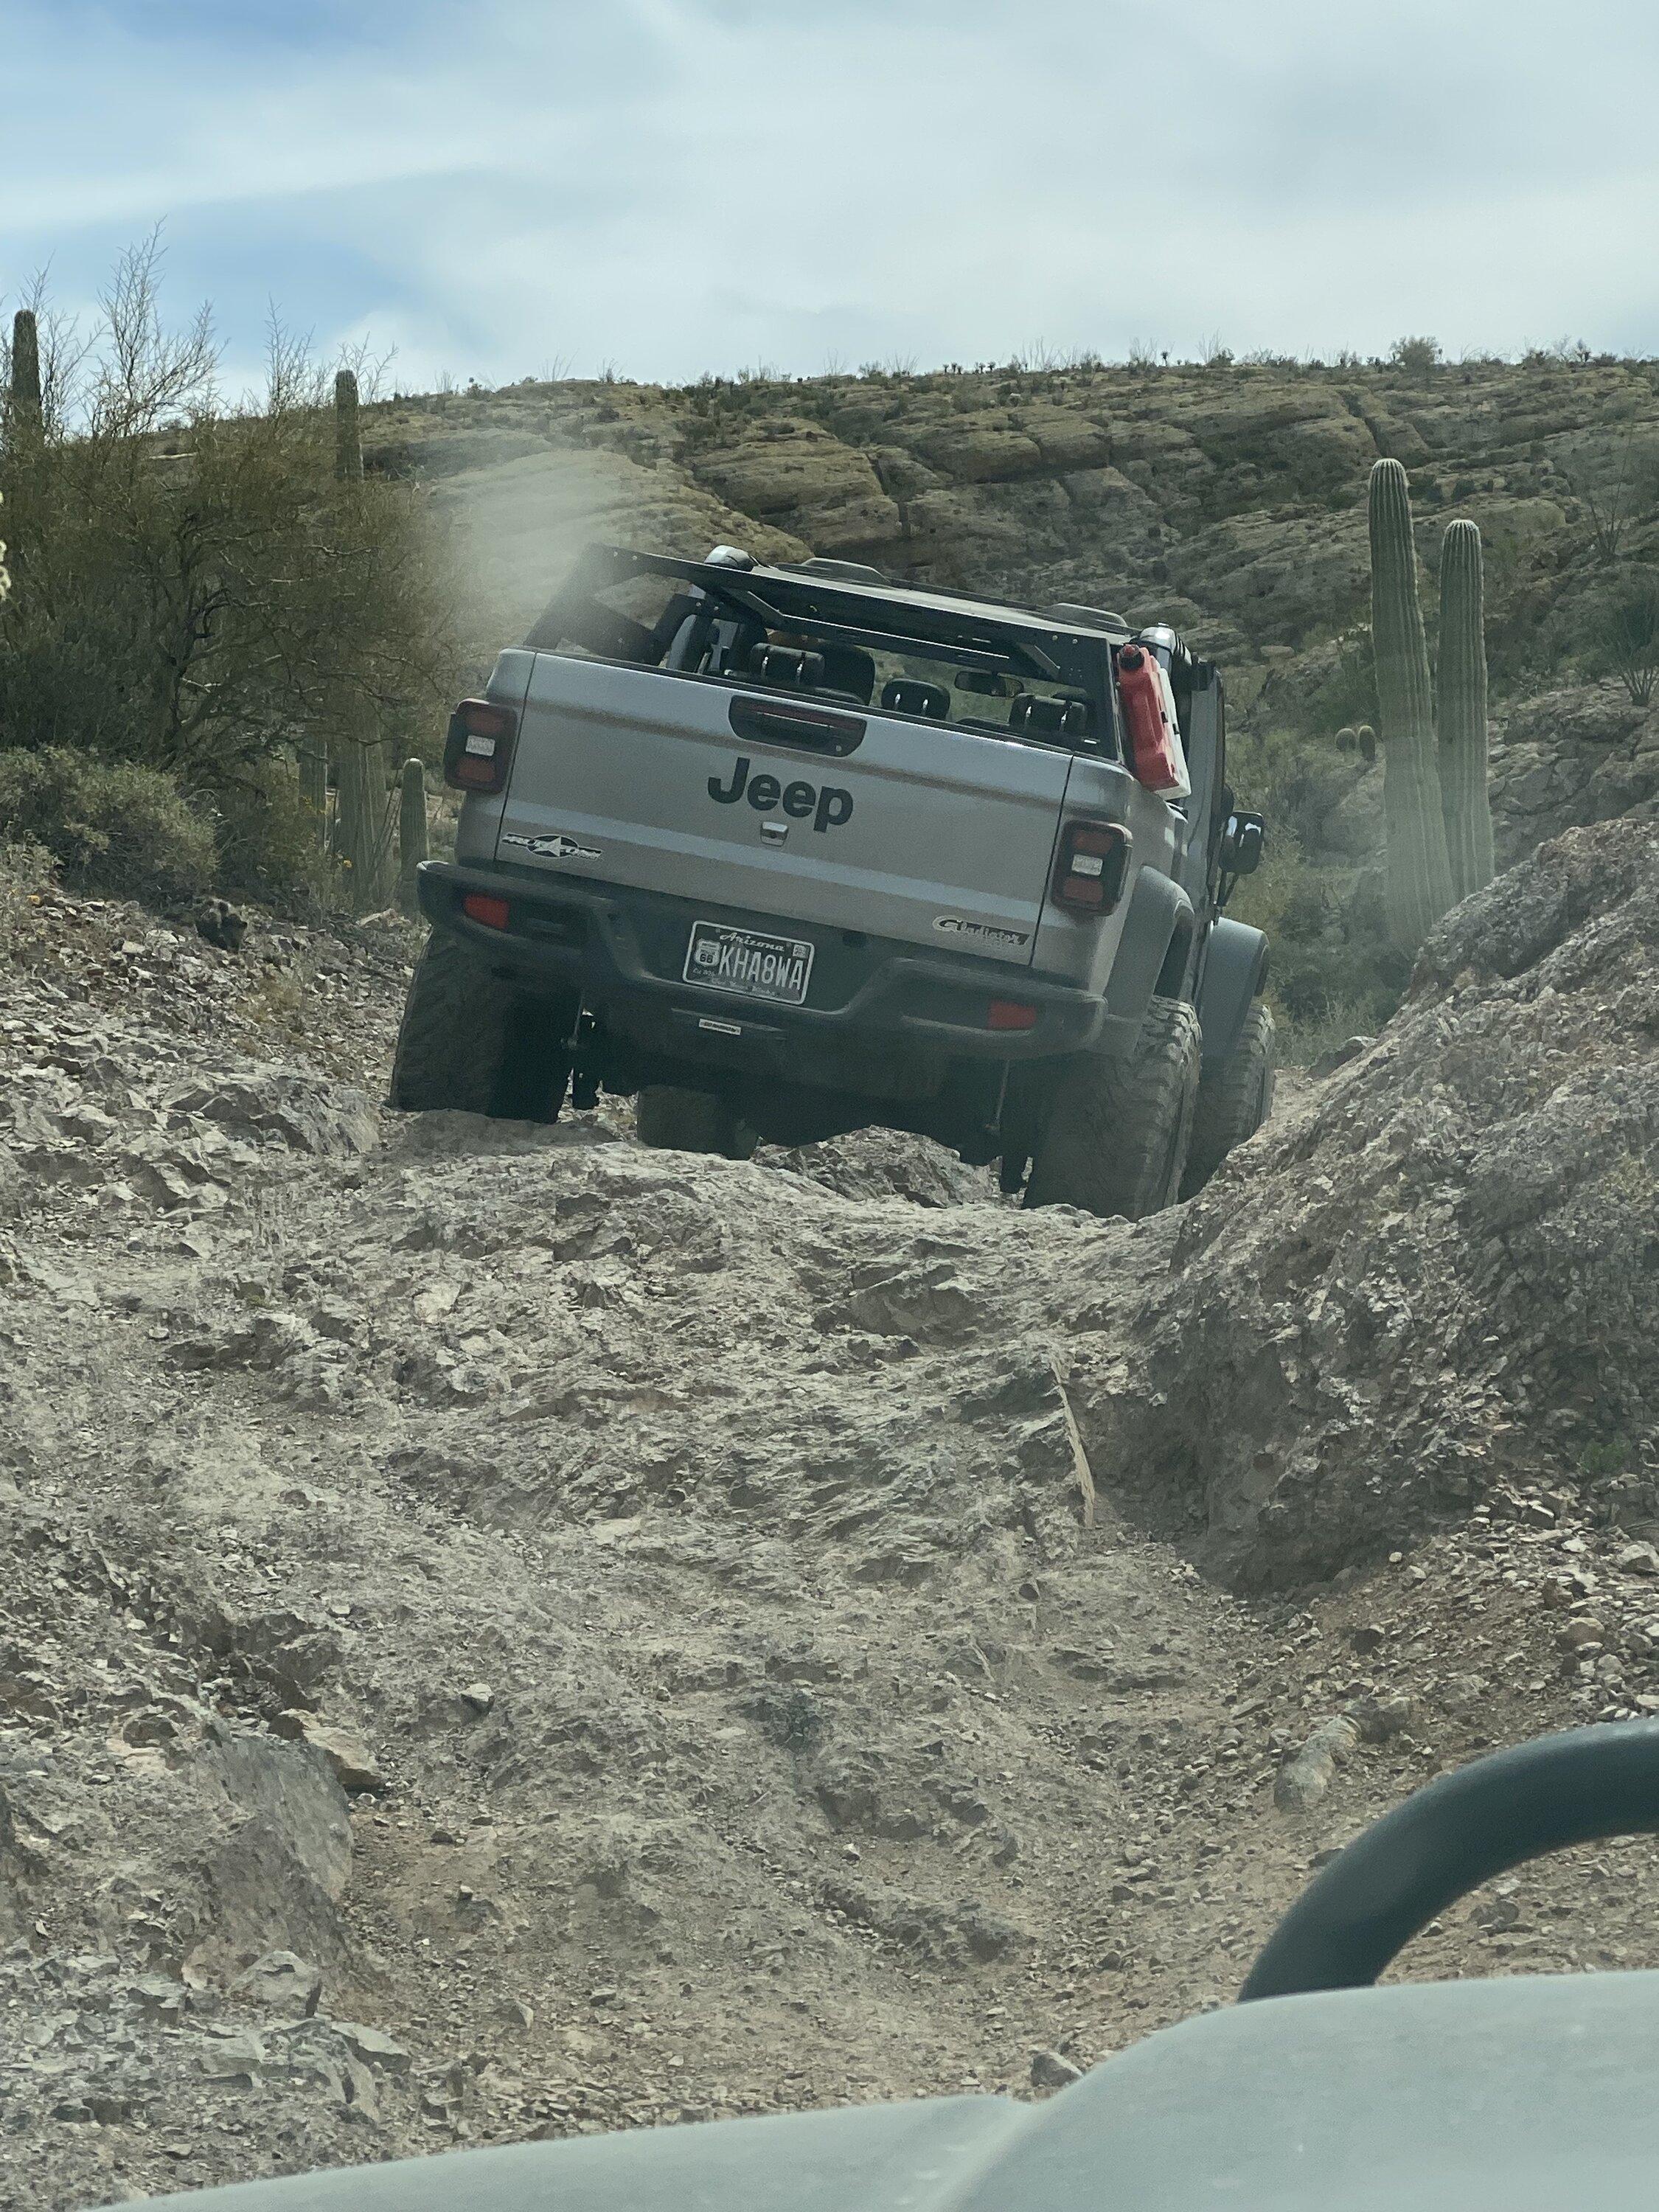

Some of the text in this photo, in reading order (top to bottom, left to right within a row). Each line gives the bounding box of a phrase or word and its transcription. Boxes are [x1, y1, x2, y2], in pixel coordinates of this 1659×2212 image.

[708, 757, 853, 832] Jeep
[720, 932, 785, 951] Arizona
[718, 945, 804, 990] KHA8WA
